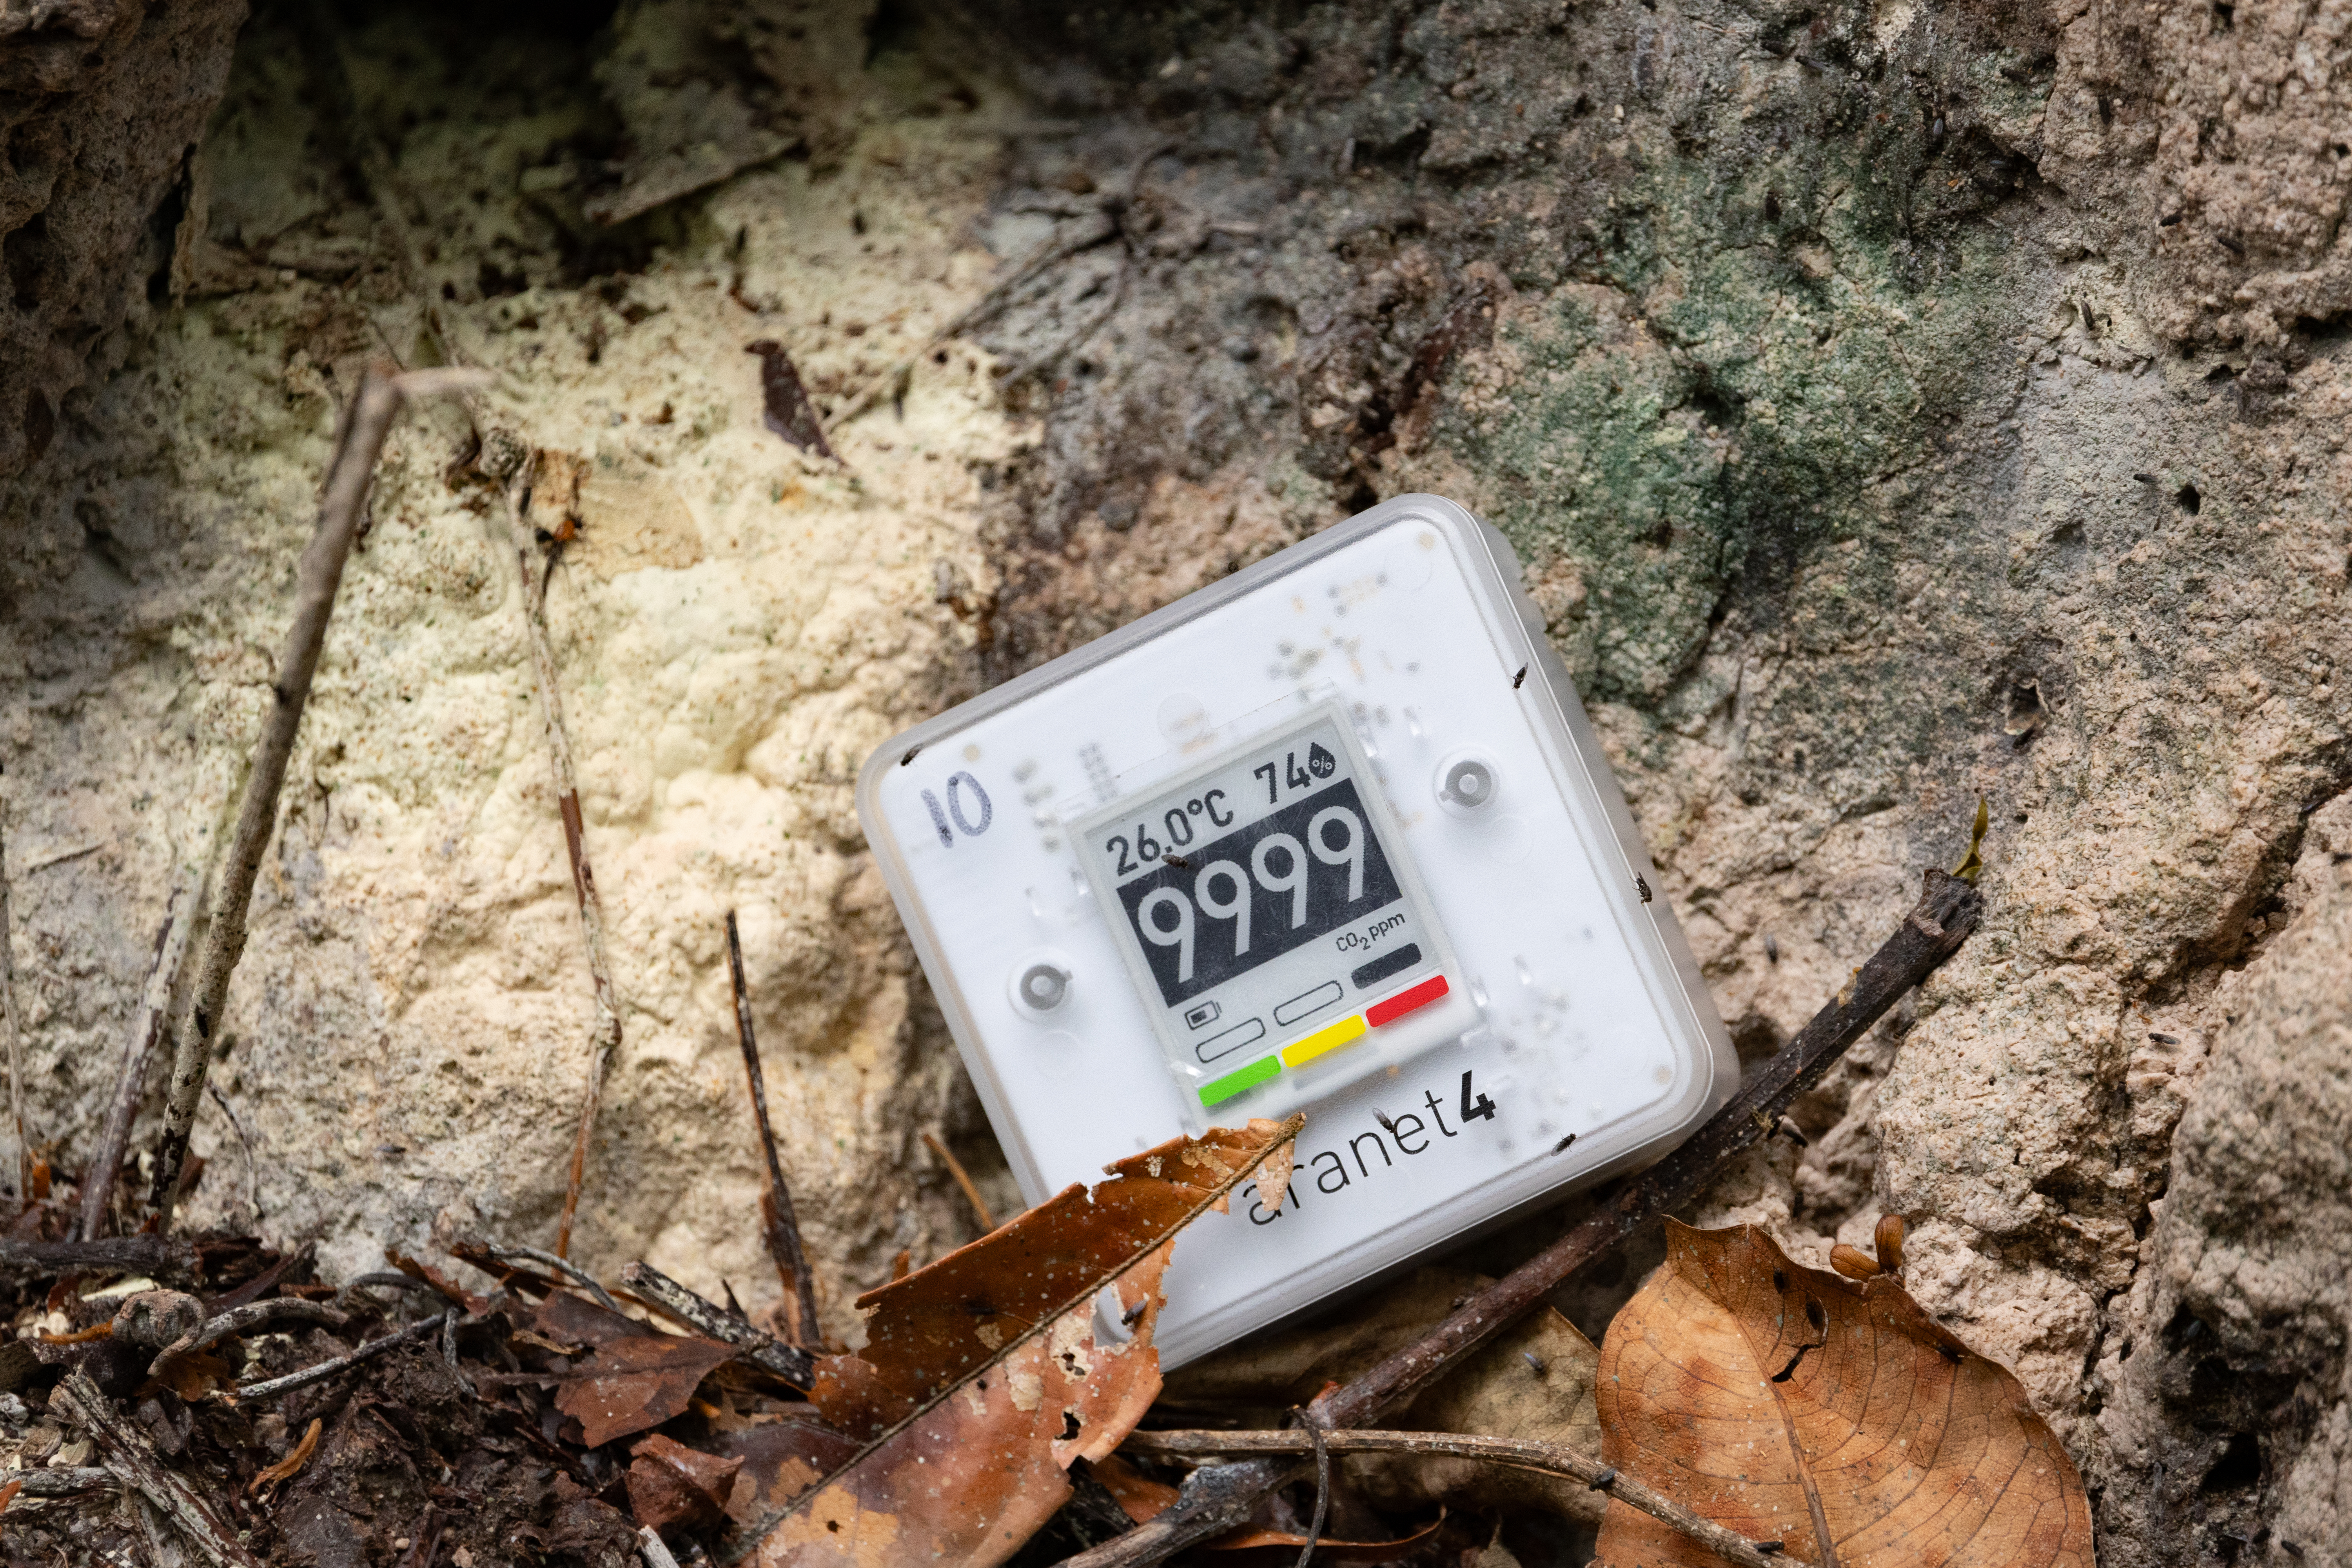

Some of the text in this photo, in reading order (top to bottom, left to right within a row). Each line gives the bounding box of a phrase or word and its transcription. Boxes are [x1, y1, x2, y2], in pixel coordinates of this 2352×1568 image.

[920, 771, 992, 848] 10
[1106, 789, 1233, 876] 26.0°C
[1138, 805, 1364, 984] 9999
[1368, 913, 1405, 941] ppm
